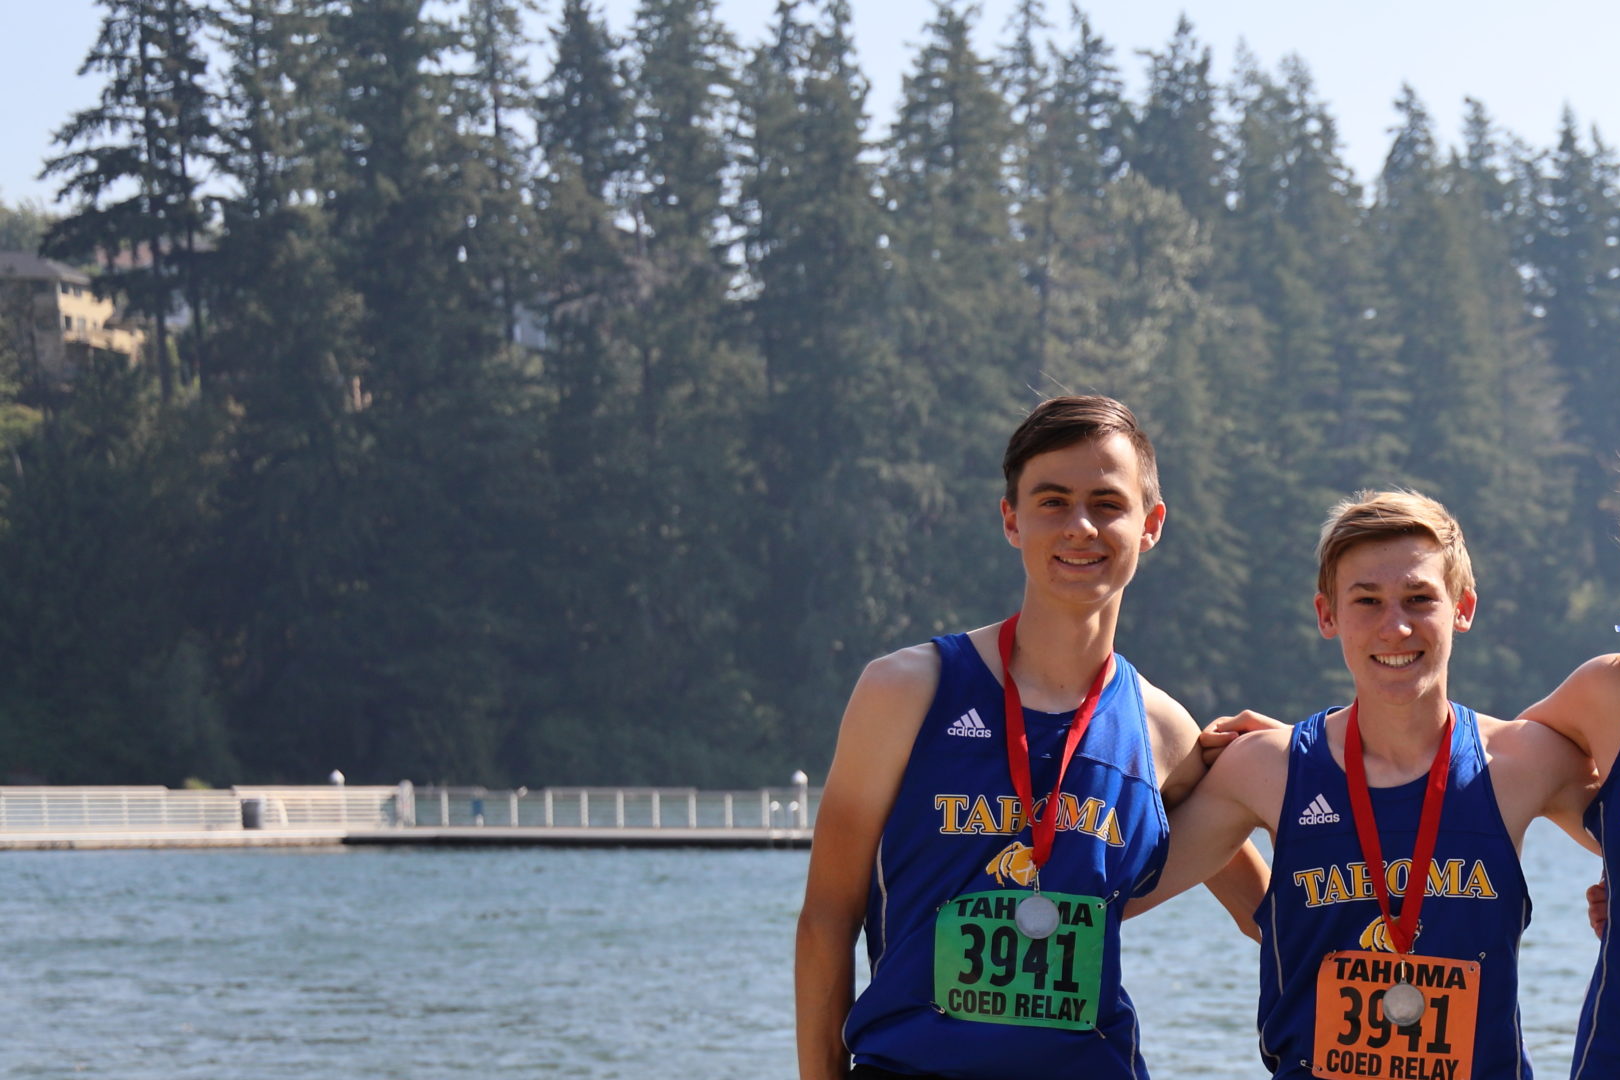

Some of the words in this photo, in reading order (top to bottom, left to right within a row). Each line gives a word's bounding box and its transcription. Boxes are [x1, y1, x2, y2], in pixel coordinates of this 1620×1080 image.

[947, 726, 992, 738] adidas
[1299, 812, 1340, 825] adidas
[956, 896, 1094, 928] TAHMA
[957, 923, 1080, 993] 3941
[1334, 957, 1467, 990] TAHOMA
[948, 988, 1007, 1015] COED
[1014, 991, 1087, 1021] RELAY
[1326, 1049, 1382, 1076] COED
